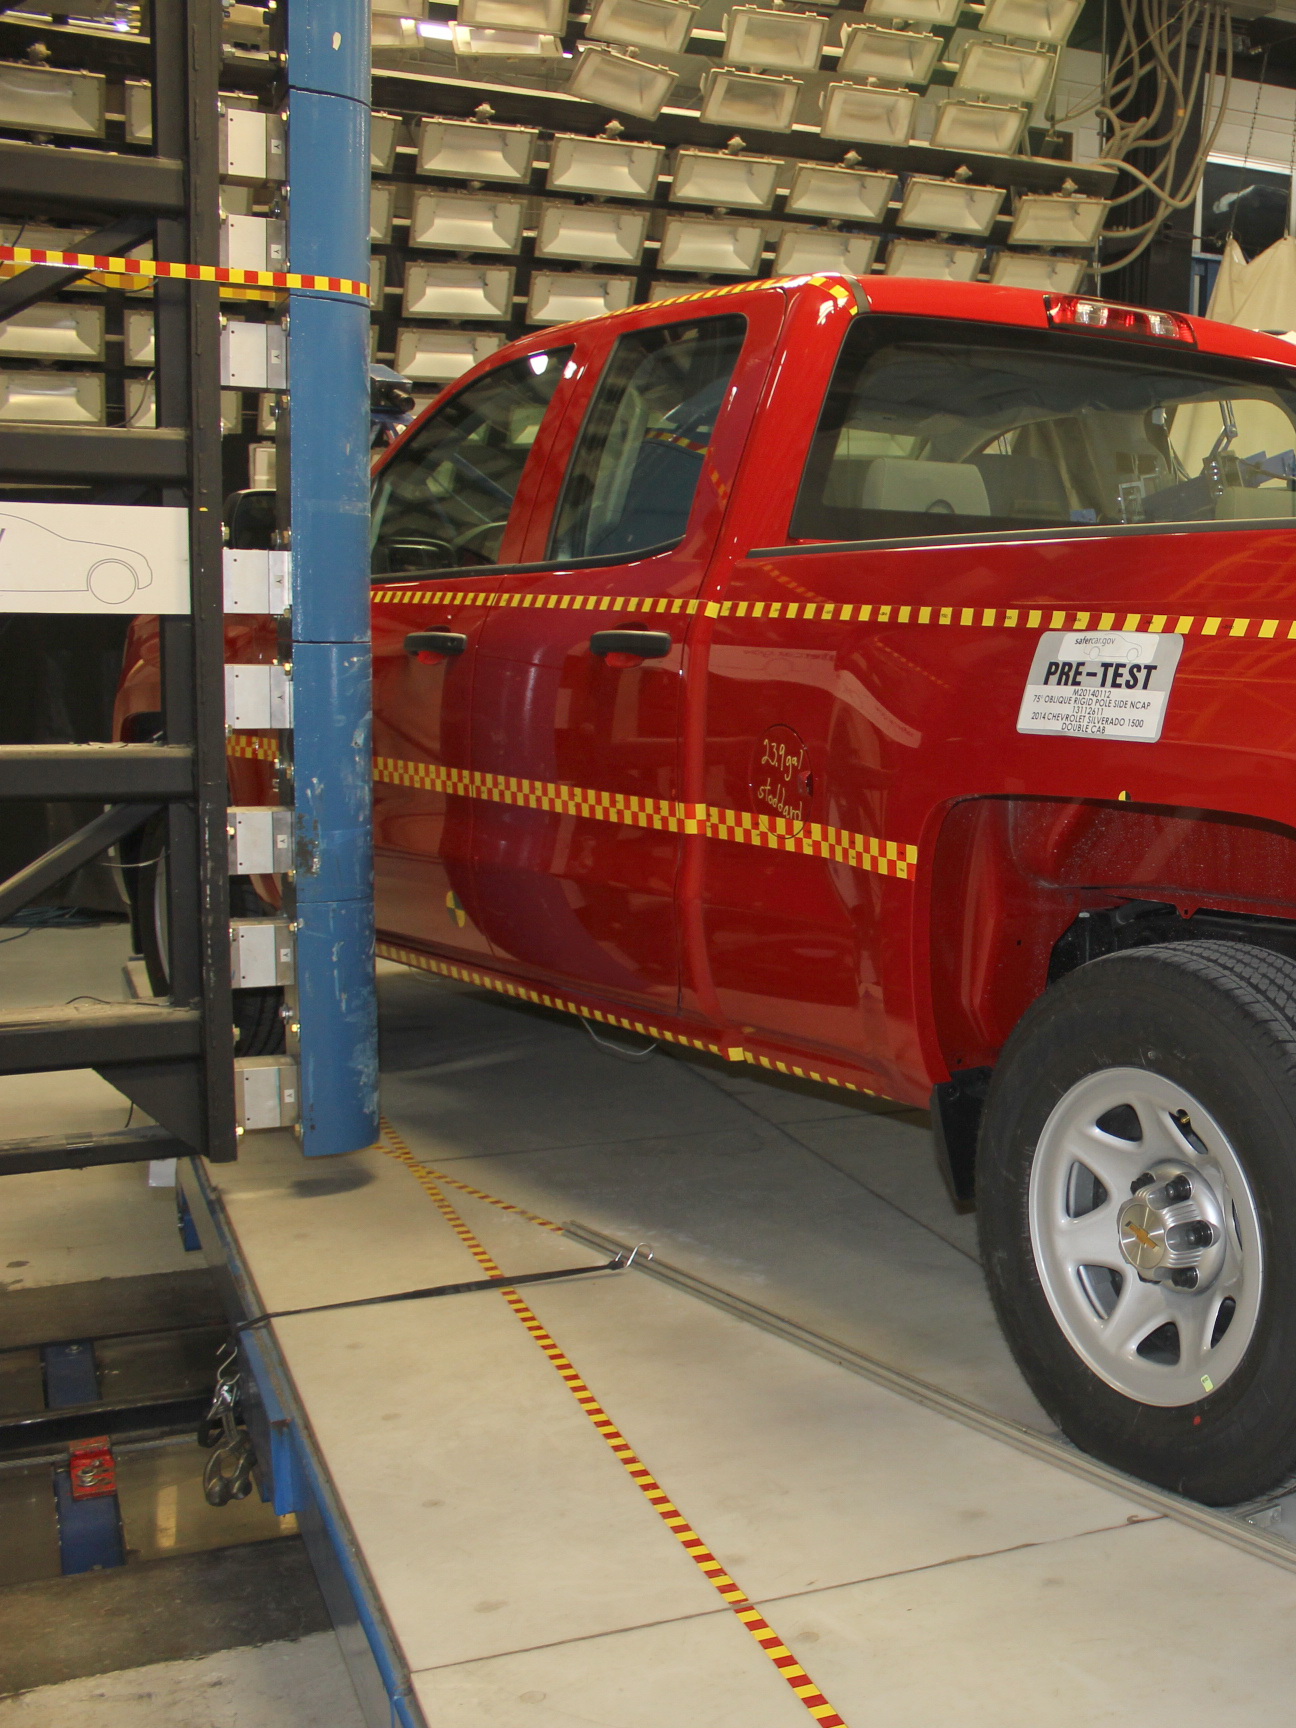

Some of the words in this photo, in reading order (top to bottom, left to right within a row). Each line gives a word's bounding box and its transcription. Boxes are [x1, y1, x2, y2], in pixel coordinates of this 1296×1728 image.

[1074, 635, 1116, 647] safercar.gov
[1043, 661, 1158, 690] PRE-TEST
[1072, 688, 1112, 699] M20140112
[1044, 695, 1073, 705] OBLIQUE
[1073, 696, 1094, 706] RIGID
[1094, 698, 1112, 708] POLE
[1113, 699, 1129, 709] SIDE
[1129, 700, 1151, 710] NCAP
[1072, 705, 1104, 716] 13112611
[1031, 711, 1047, 720] 2014
[1047, 712, 1086, 723] CHEVROLET
[1087, 715, 1126, 727] SILVERADO
[1127, 718, 1144, 728] 1500
[1061, 722, 1090, 733] DOUBLE
[1090, 724, 1106, 734] CAB
